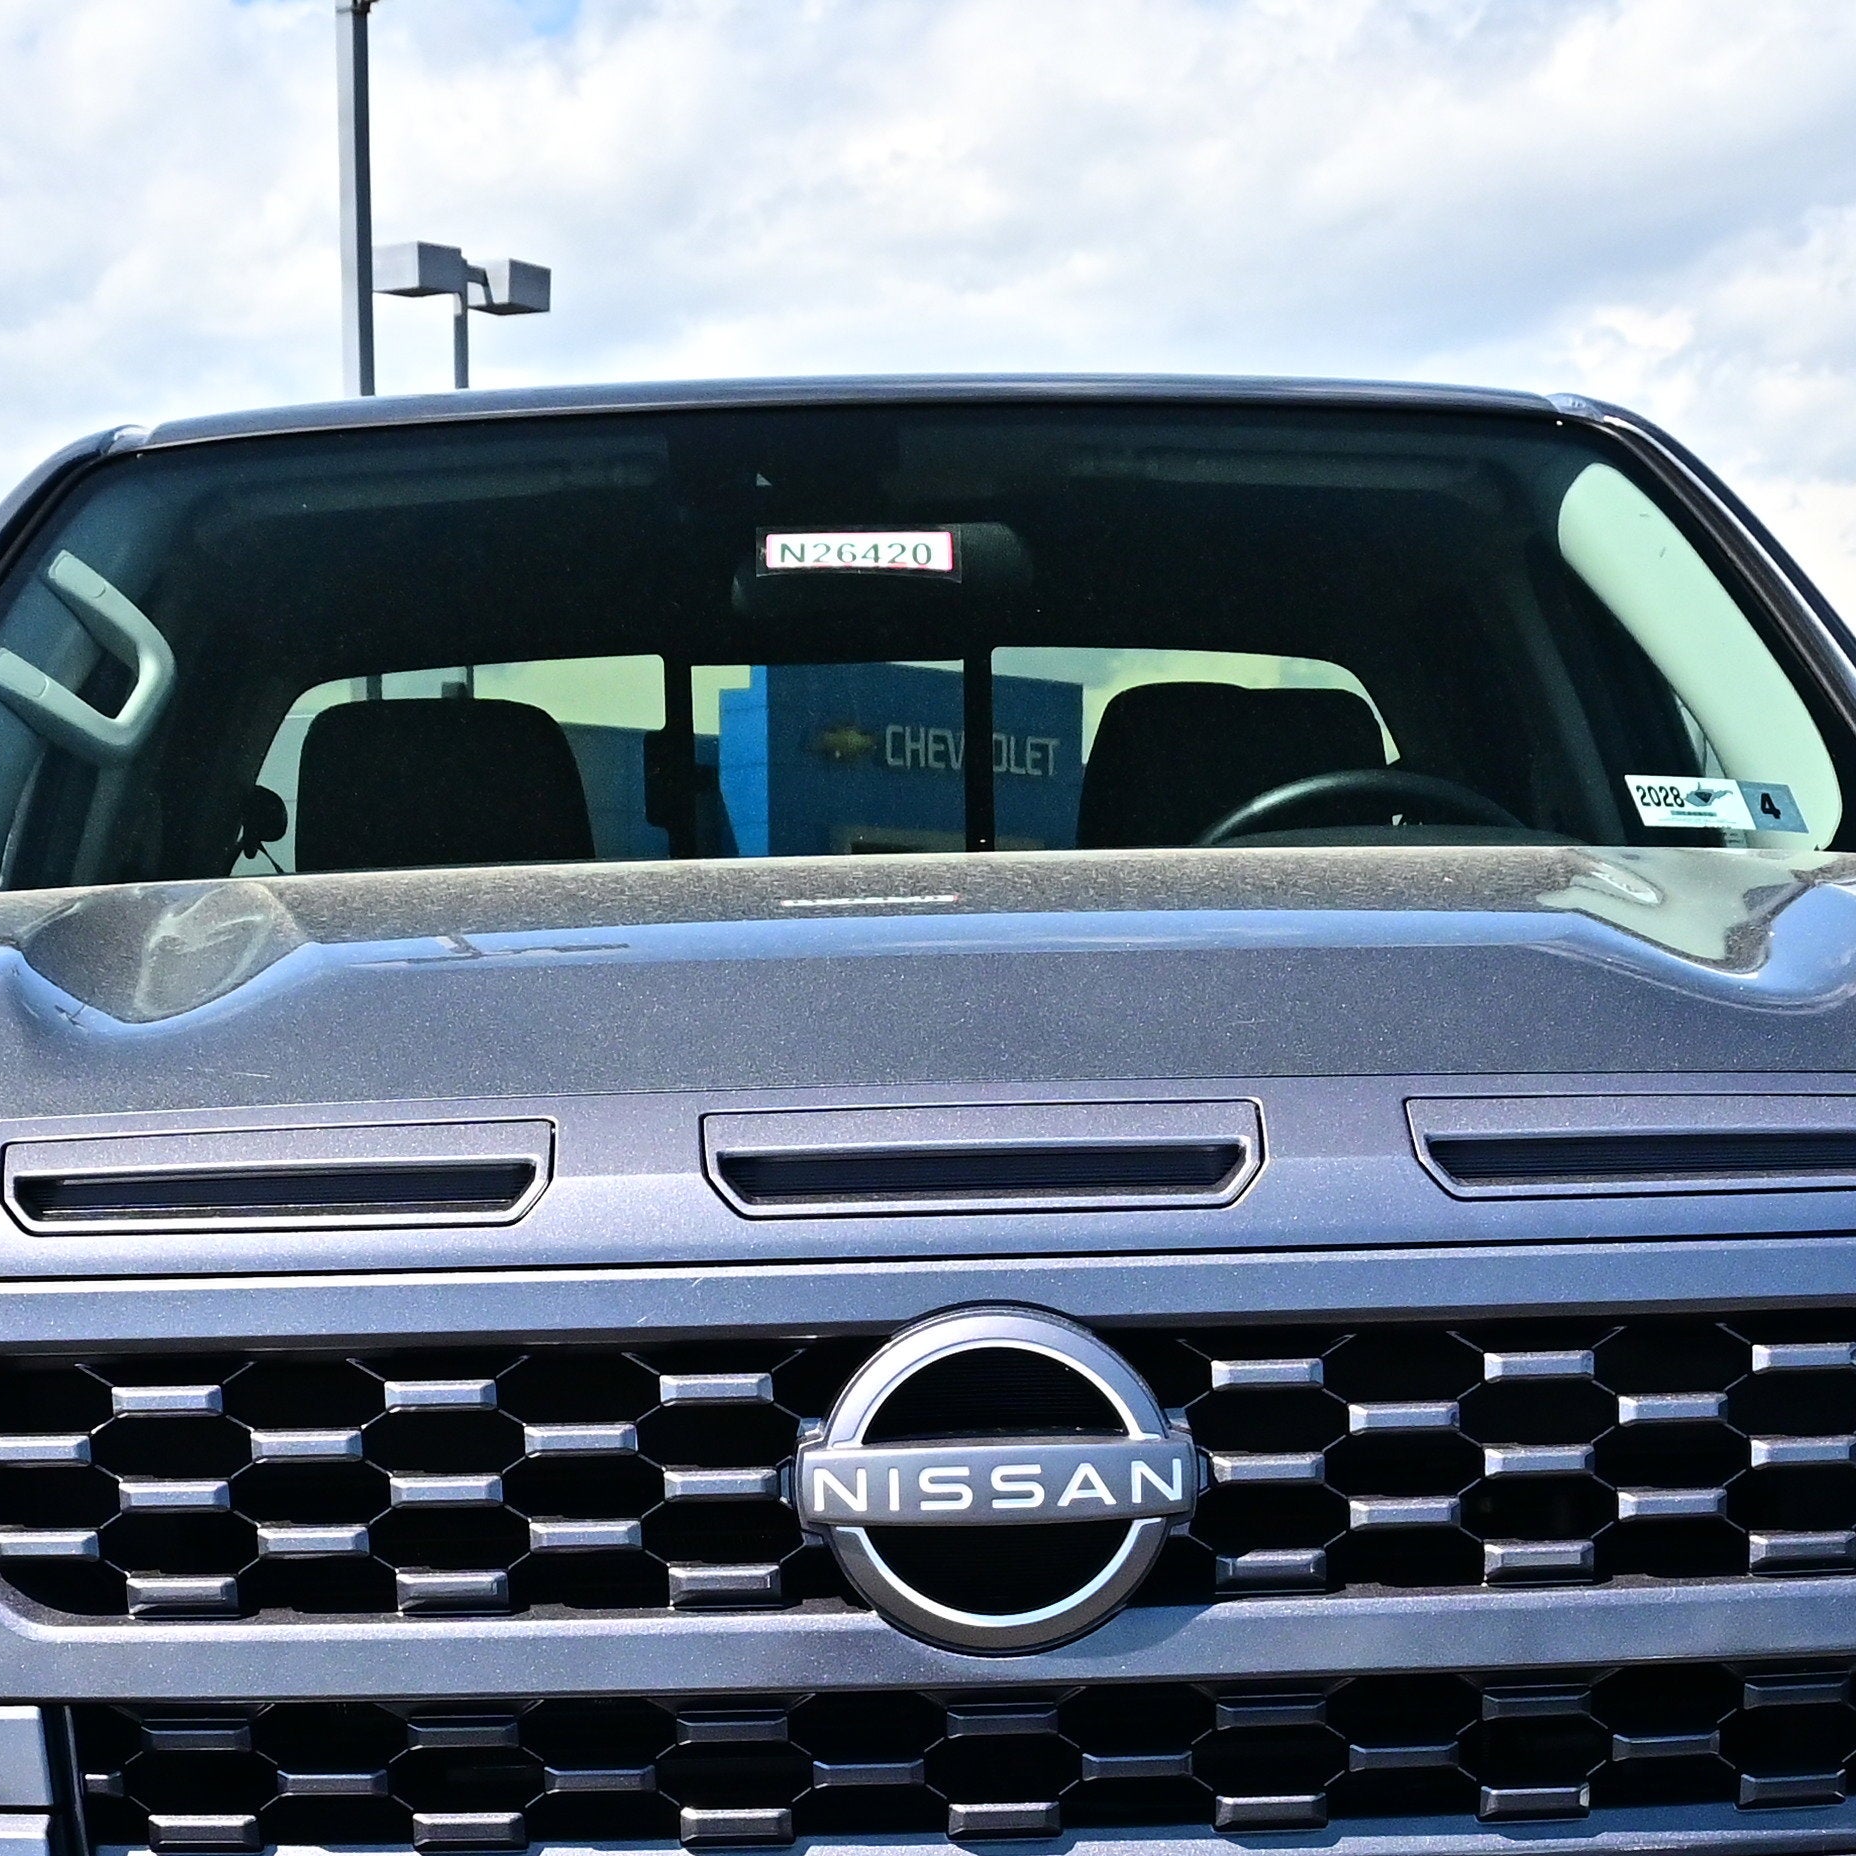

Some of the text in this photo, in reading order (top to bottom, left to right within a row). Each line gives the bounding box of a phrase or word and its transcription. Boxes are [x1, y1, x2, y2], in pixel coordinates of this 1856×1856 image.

[779, 542, 932, 565] N26420
[885, 725, 1061, 776] CHEVOLET
[1635, 785, 1685, 808] 2028
[1759, 792, 1782, 820] 4
[813, 1458, 1183, 1512] NISSAN
